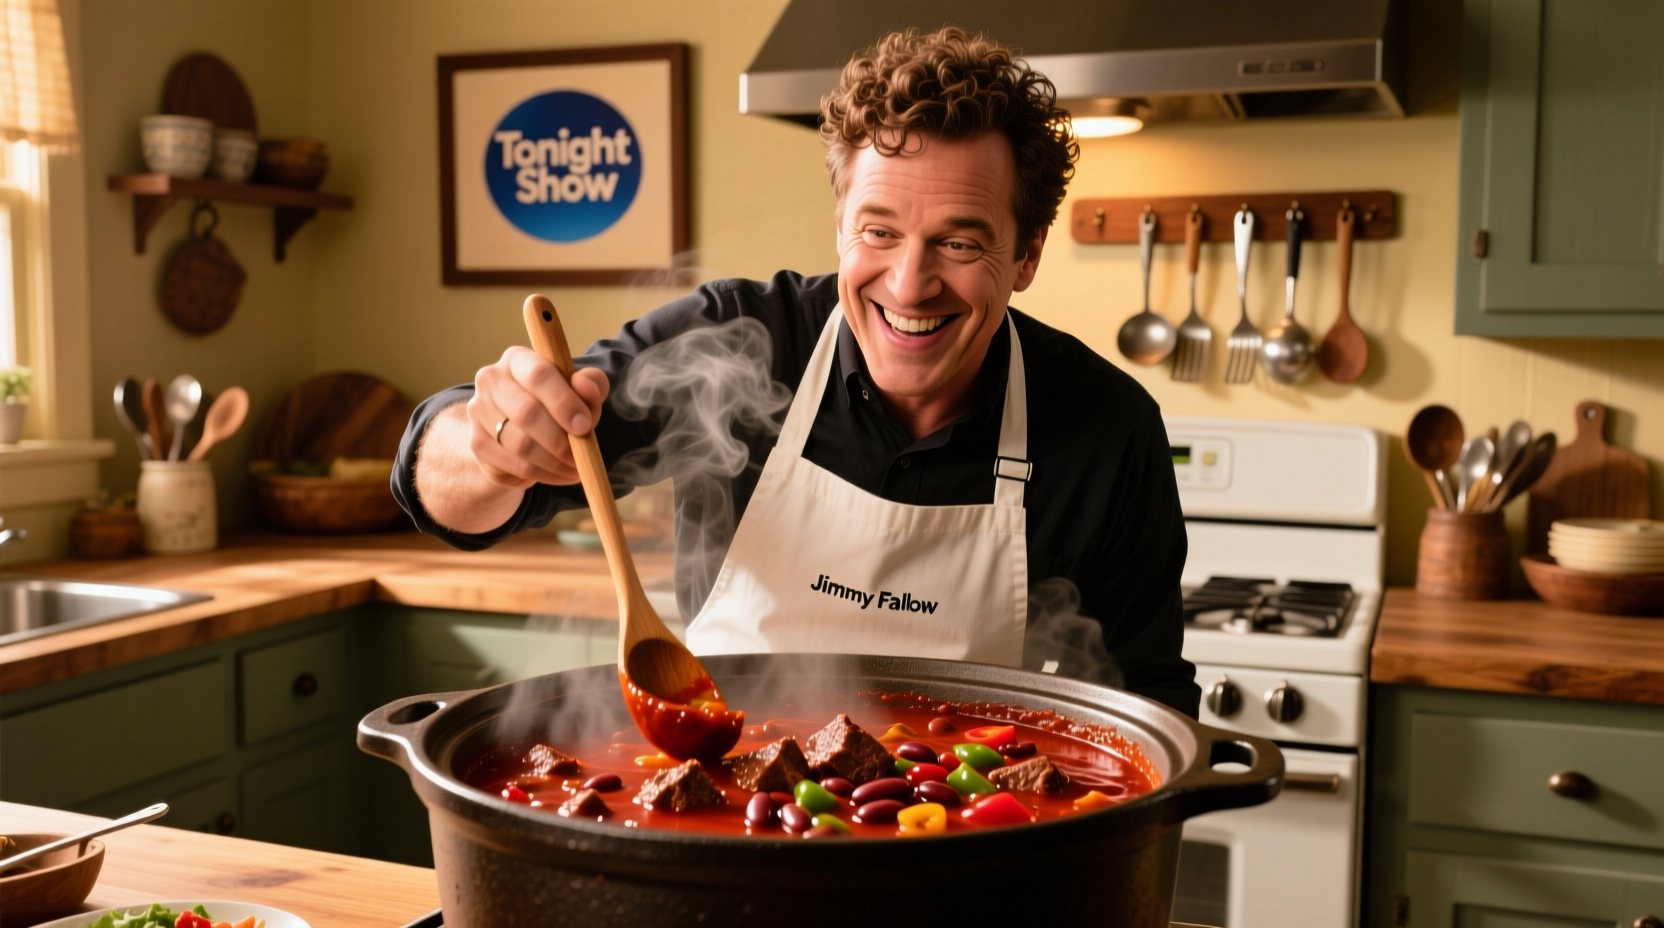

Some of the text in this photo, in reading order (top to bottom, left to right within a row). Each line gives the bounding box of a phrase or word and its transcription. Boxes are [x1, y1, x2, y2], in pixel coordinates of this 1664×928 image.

[494, 126, 632, 174] Tonight
[515, 165, 619, 204] Show
[810, 574, 939, 615] Jimmy Fallow
